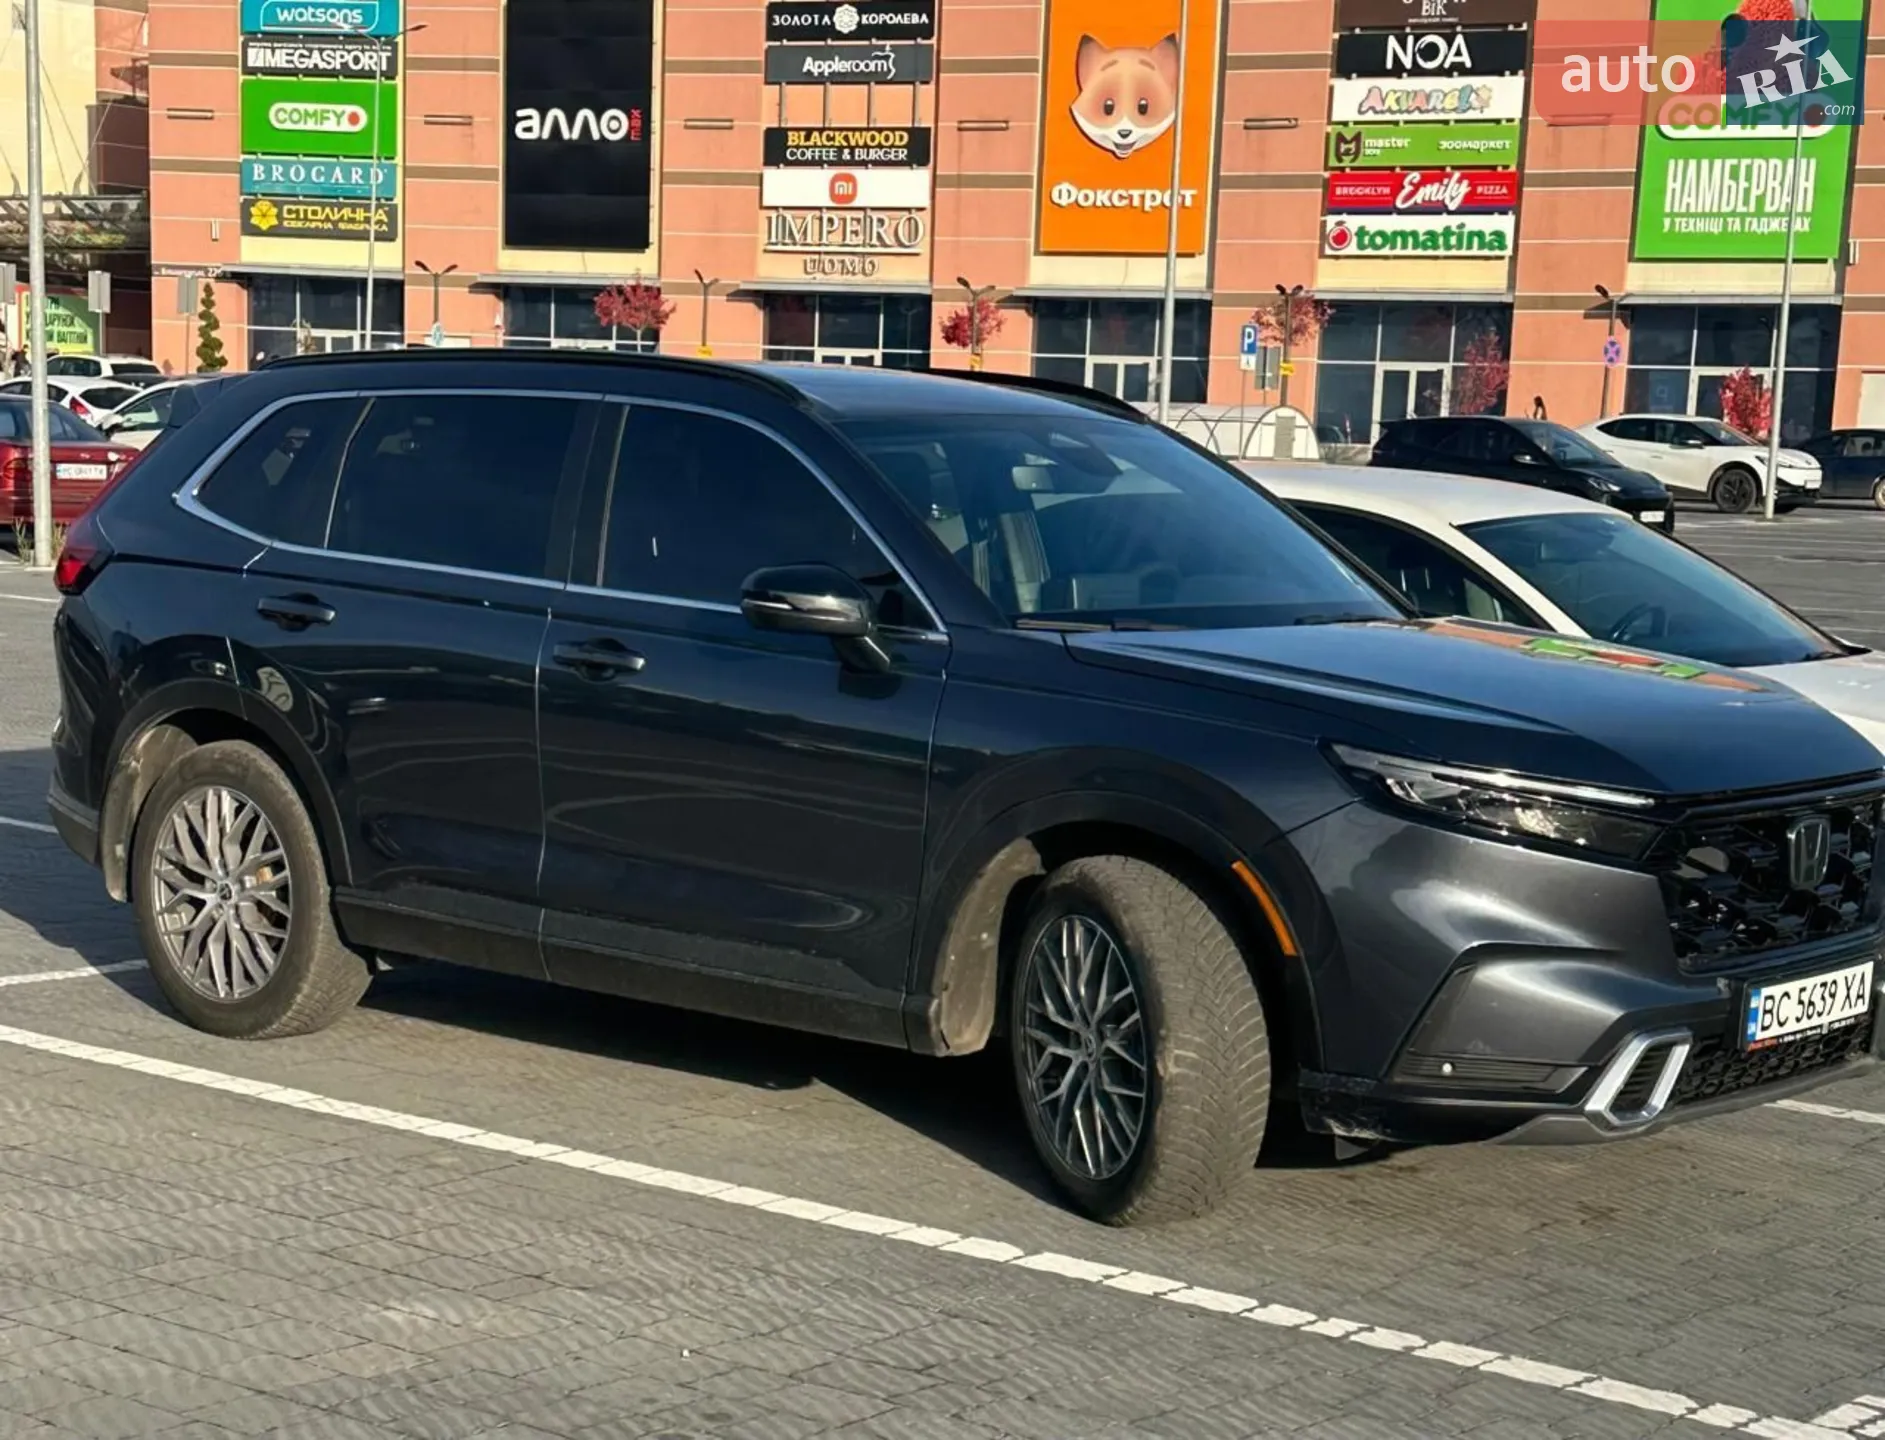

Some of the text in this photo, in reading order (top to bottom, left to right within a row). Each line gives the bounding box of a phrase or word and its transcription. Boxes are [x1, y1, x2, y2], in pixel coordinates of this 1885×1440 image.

[276, 7, 364, 24] watsons
[772, 12, 929, 26] ЗОЛОТА КОРОЛЕВА
[265, 47, 392, 71] MEGASPORT
[1385, 33, 1472, 70] NOA
[802, 55, 888, 76] Appleroom
[274, 107, 347, 127] COMFY
[1668, 102, 1799, 130] COMFY
[787, 130, 910, 146] BLACKWOOD
[1365, 137, 1411, 149] master
[1438, 139, 1512, 153] зоомаркет
[786, 148, 908, 161] COFFEE & BURGER
[252, 163, 385, 185] BROCARD
[1335, 171, 1509, 210] BROOKLYN Emily PIZZA
[1664, 157, 1817, 213] НАМБЕРВАН
[1050, 182, 1198, 212] Фокстрот
[282, 204, 389, 223] СТОЛИЧНА
[766, 211, 925, 248] IMPERO
[1727, 217, 1742, 232] ТА
[1745, 217, 1812, 234] ГАДЖЕАХ
[1355, 222, 1509, 251] tomatina
[804, 256, 880, 277] UOMO
[1244, 327, 1254, 352] P
[1760, 971, 1866, 1032] BC 5639 XA
